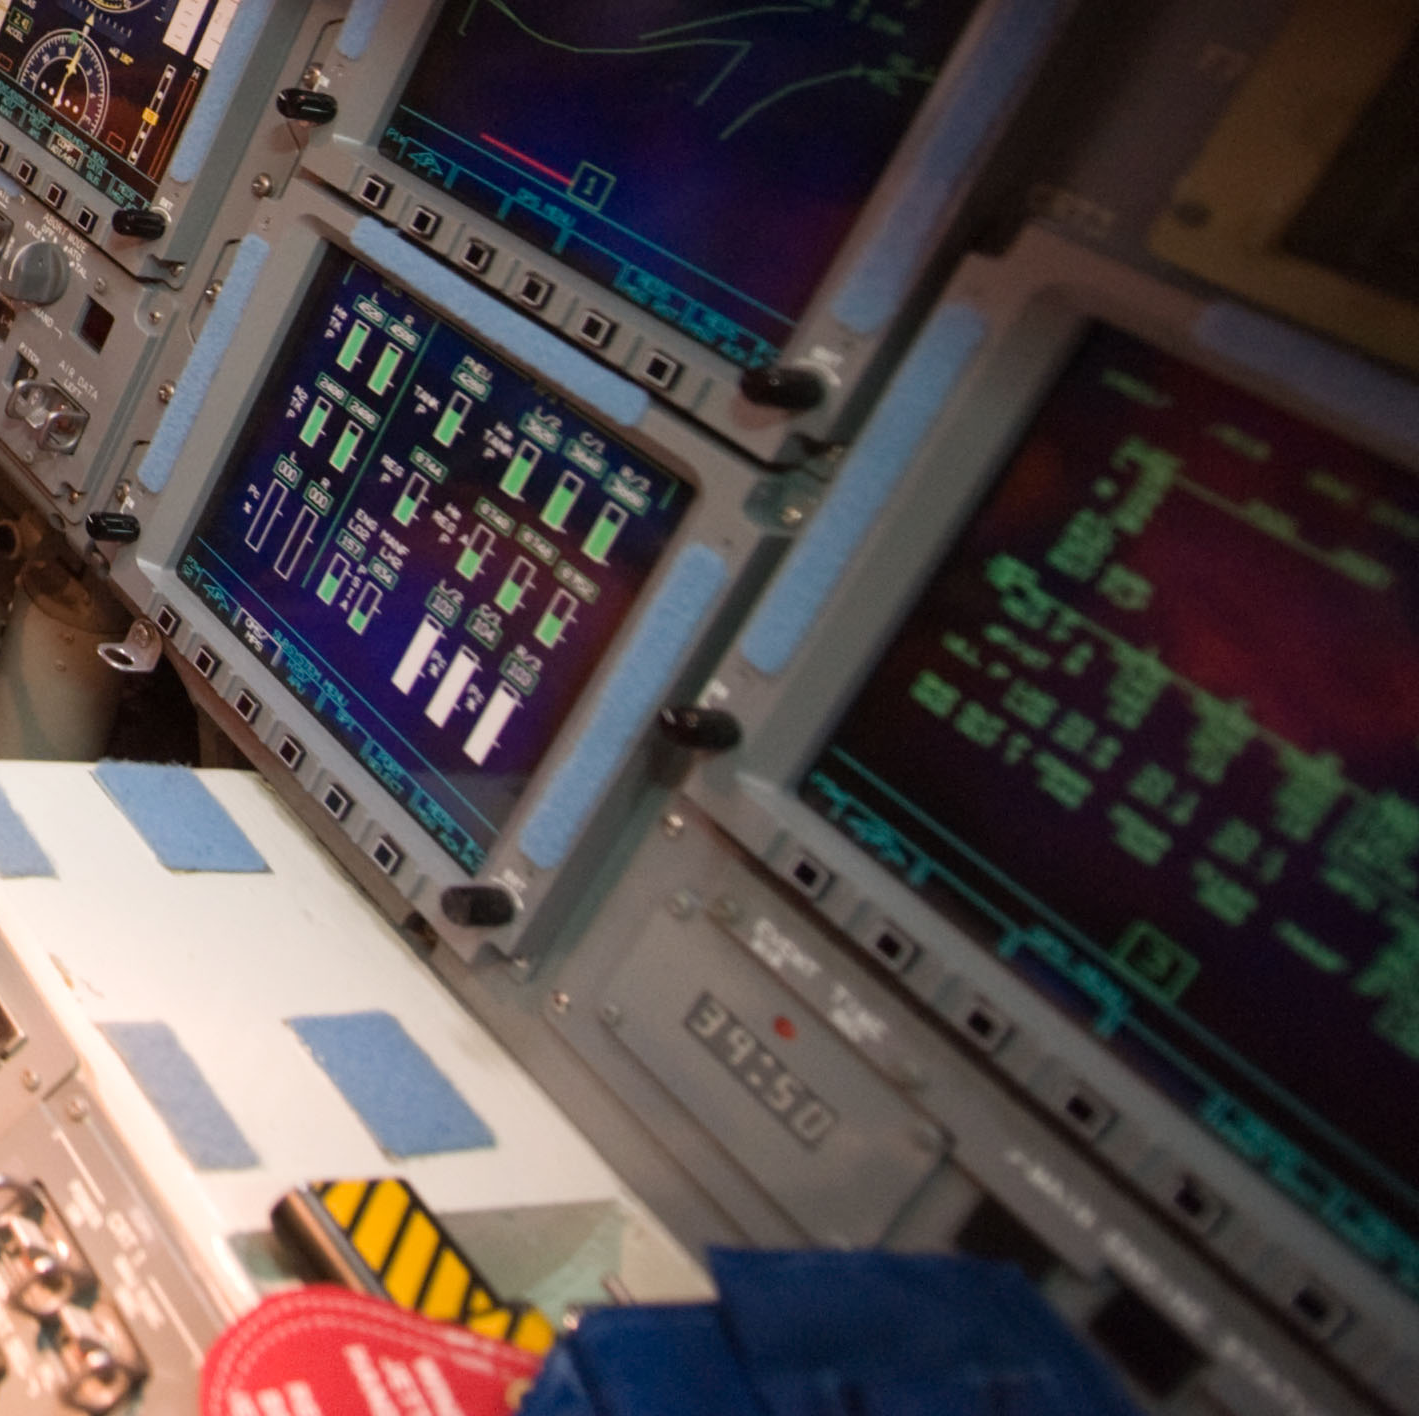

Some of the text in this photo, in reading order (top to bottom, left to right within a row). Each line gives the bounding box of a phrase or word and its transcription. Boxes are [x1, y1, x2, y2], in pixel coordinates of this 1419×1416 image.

[42, 210, 88, 255] ABORT MODE
[18, 340, 41, 365] PITCH
[58, 357, 99, 401] AIR DATA
[410, 382, 442, 413] TANK
[378, 452, 406, 480] REG
[353, 506, 379, 534] ENG
[243, 629, 264, 653] MPS
[320, 677, 349, 709] MENU
[688, 1002, 831, 1146] 39:50
